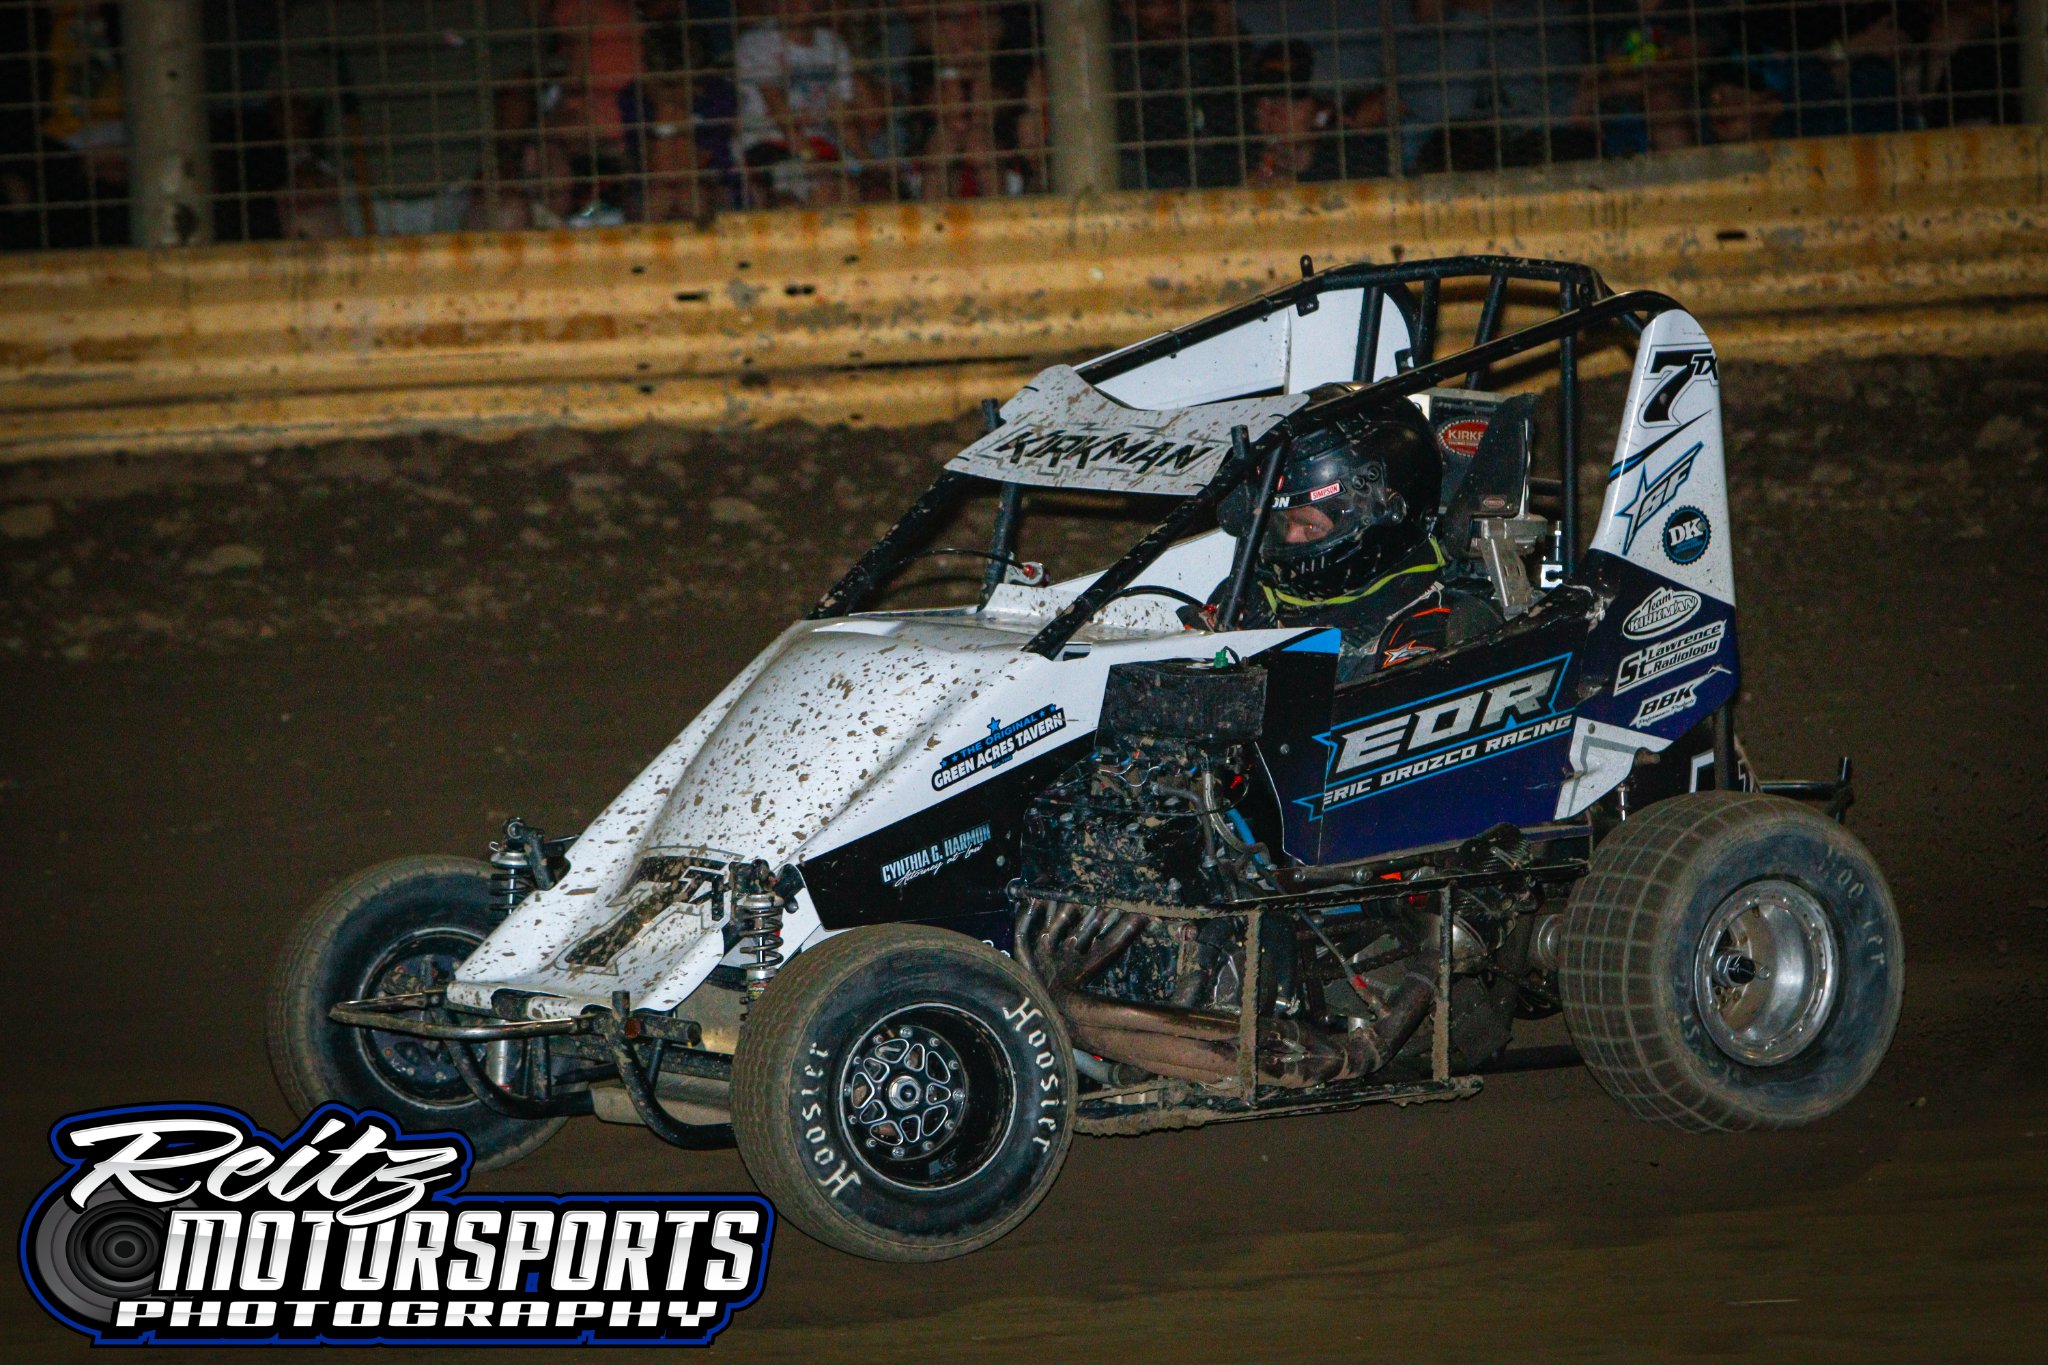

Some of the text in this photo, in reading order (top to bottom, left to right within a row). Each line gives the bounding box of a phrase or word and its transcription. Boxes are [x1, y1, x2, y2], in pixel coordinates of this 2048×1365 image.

[993, 430, 1214, 474] KIRKMAN
[1312, 484, 1339, 500] SIMPSON
[1669, 518, 1704, 547] DK
[1642, 590, 1671, 613] Team
[1619, 624, 1721, 688] St. Lawrence
[1653, 640, 1718, 673] Radiology
[1336, 669, 1556, 773] EOR
[1640, 684, 1693, 717] BBK
[933, 761, 975, 788] GREEN
[977, 739, 1014, 769] ACRES
[1015, 712, 1064, 747] TAVERN
[960, 715, 1038, 759] THE ORIGINAL
[1323, 714, 1572, 805] ERIC OROZCO RACING
[882, 849, 930, 883] CYNTHIA
[944, 823, 991, 857] HARMON
